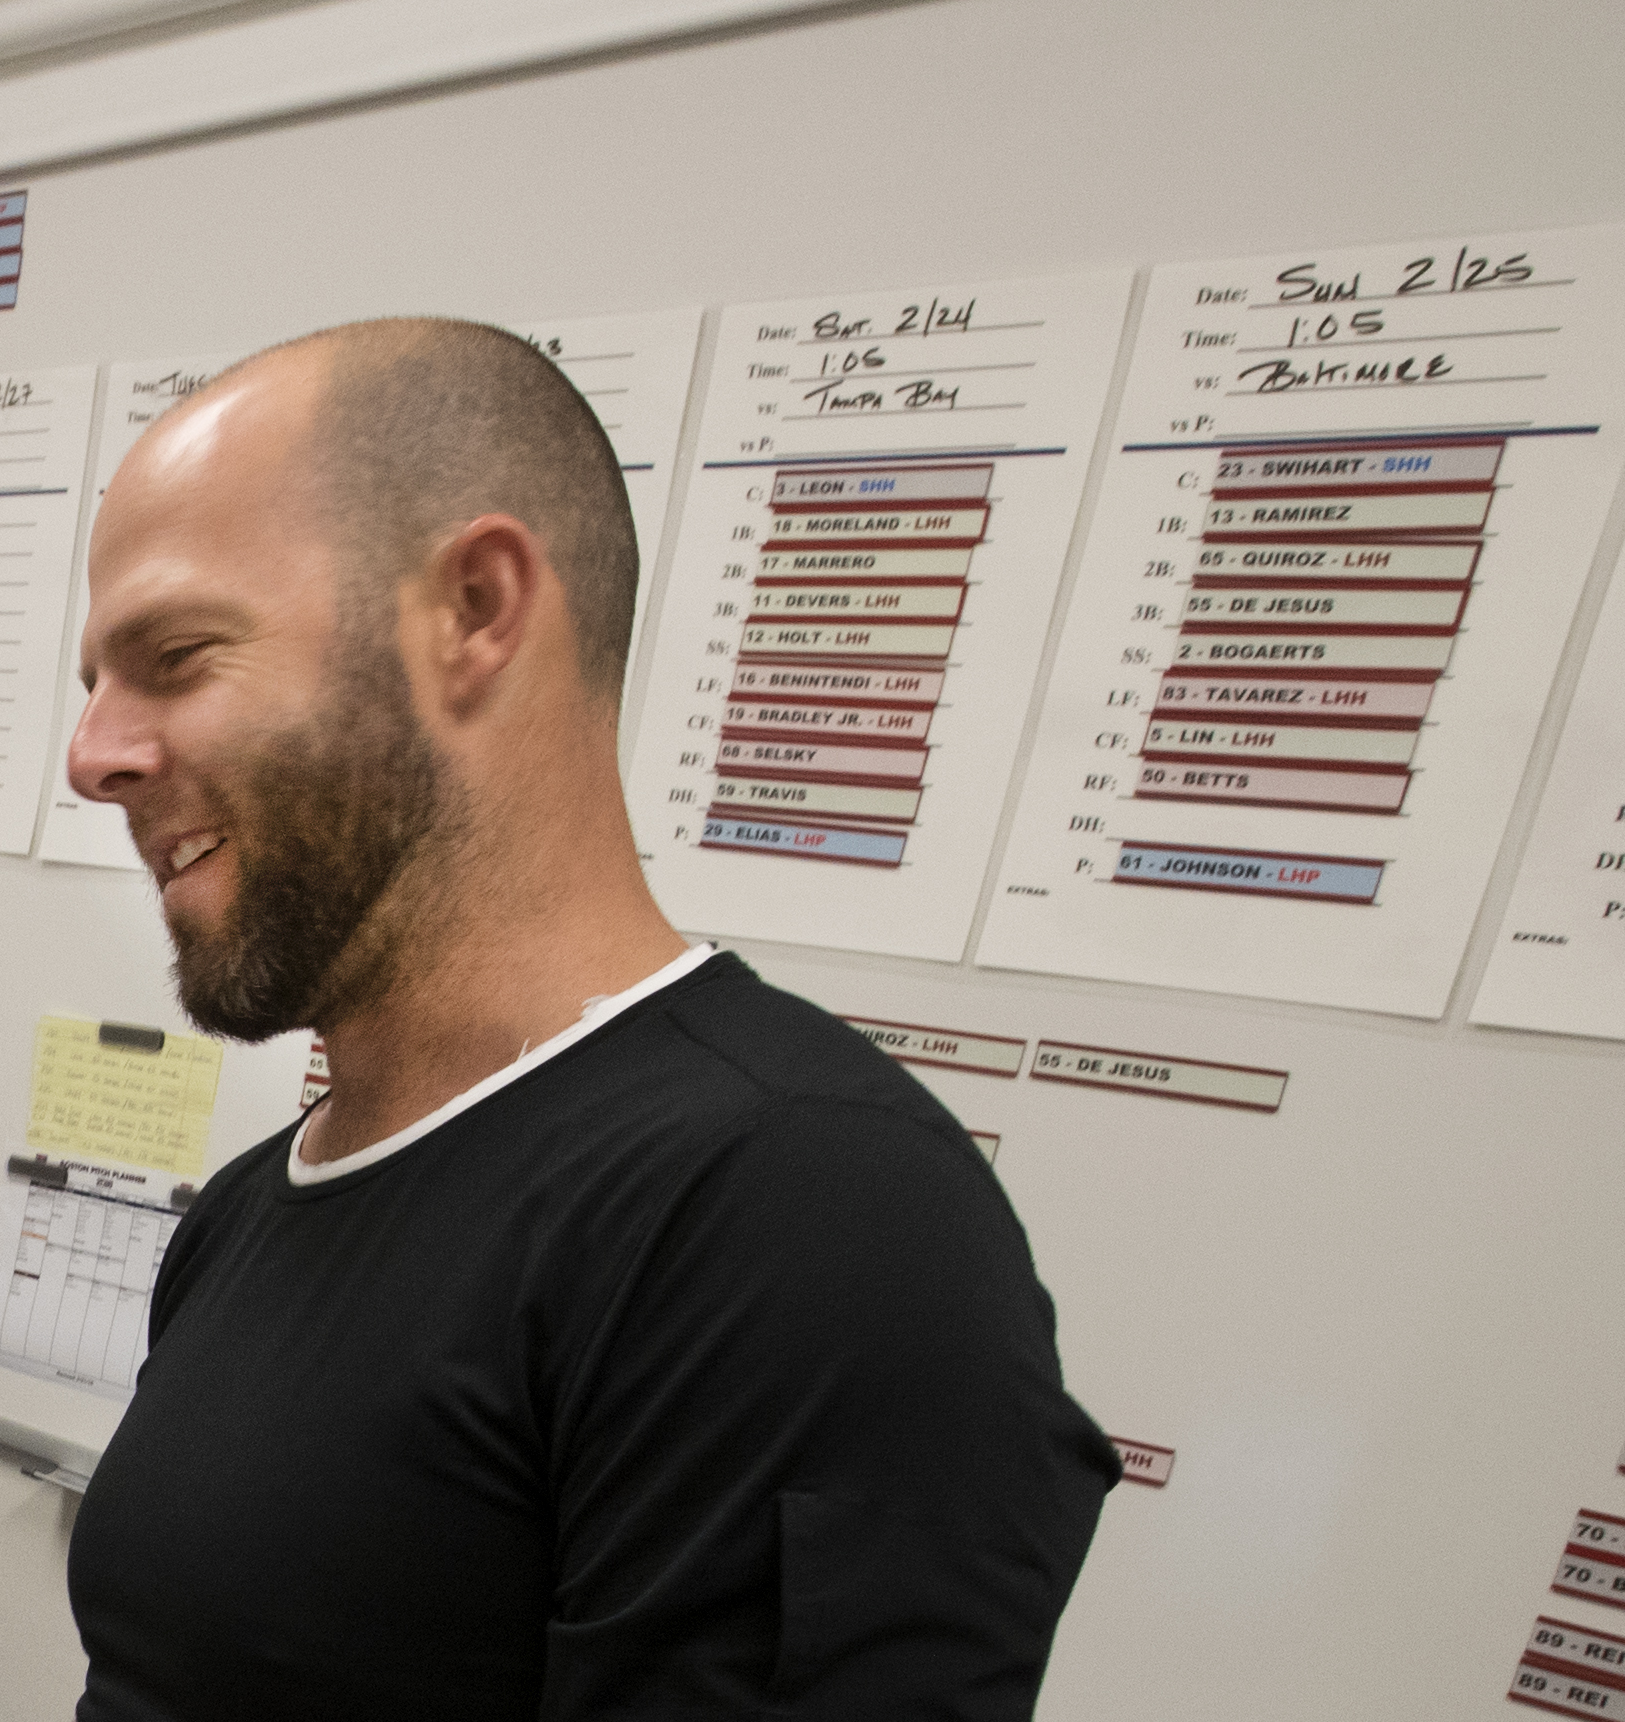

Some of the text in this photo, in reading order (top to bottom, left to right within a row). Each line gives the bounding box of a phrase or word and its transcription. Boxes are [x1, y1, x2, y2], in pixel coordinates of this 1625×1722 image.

[1397, 245, 1533, 297] 2/25
[1196, 287, 1248, 305] Date:
[895, 297, 976, 338] 2/24
[757, 326, 796, 341] Date:
[1287, 308, 1384, 349] 1:05
[1183, 330, 1236, 349] Time:
[748, 363, 789, 378] Time:
[1194, 376, 1219, 389] vs:
[1170, 414, 1214, 433] vs P:
[1217, 455, 1433, 480] 23 SWIHART SHH
[799, 480, 845, 495] LEON
[1177, 472, 1199, 490] C:
[773, 515, 952, 533] 18 MORELAND LHH
[1210, 505, 1353, 525] 13 RAMIREZ
[761, 556, 876, 571] 17 MARRERO
[1199, 551, 1392, 568] 65 QUIROZ LHH
[1144, 562, 1174, 578] 2B:
[753, 594, 901, 609] 11 DEVERS LHH
[1187, 598, 1334, 615] 55 DE JESUS
[1131, 604, 1163, 622] 3B:
[746, 630, 870, 646] 12 HOLT LHH
[1178, 644, 1326, 660] 2 BOGAERTS
[738, 672, 922, 692] 16 BENINTENDI LHH
[1107, 689, 1140, 707] LF:
[1163, 686, 1368, 707] 83 TAVAREZ LHH
[727, 707, 914, 730] 19 BRADLEY JR. LHH
[1095, 731, 1128, 750] CF:
[1150, 727, 1276, 748] 5 LIN LHH
[753, 746, 817, 763] SELSKY
[1083, 774, 1117, 791] RF:
[1142, 768, 1250, 789] 50 BETTS
[750, 785, 807, 801] TRAVIS
[1068, 815, 1105, 834] DH:
[704, 823, 827, 847] 29 ELIAS LHP
[1075, 856, 1093, 875] P:
[1119, 854, 1321, 885] 61 JOHNSON LHP
[855, 1028, 959, 1055] UIROZ LHH
[1040, 1053, 1171, 1082] 55 DE JESUS
[1577, 1522, 1605, 1542] 70
[1563, 1565, 1592, 1584] 70
[1535, 1629, 1564, 1648] 89
[1518, 1673, 1608, 1709] 89 REI
